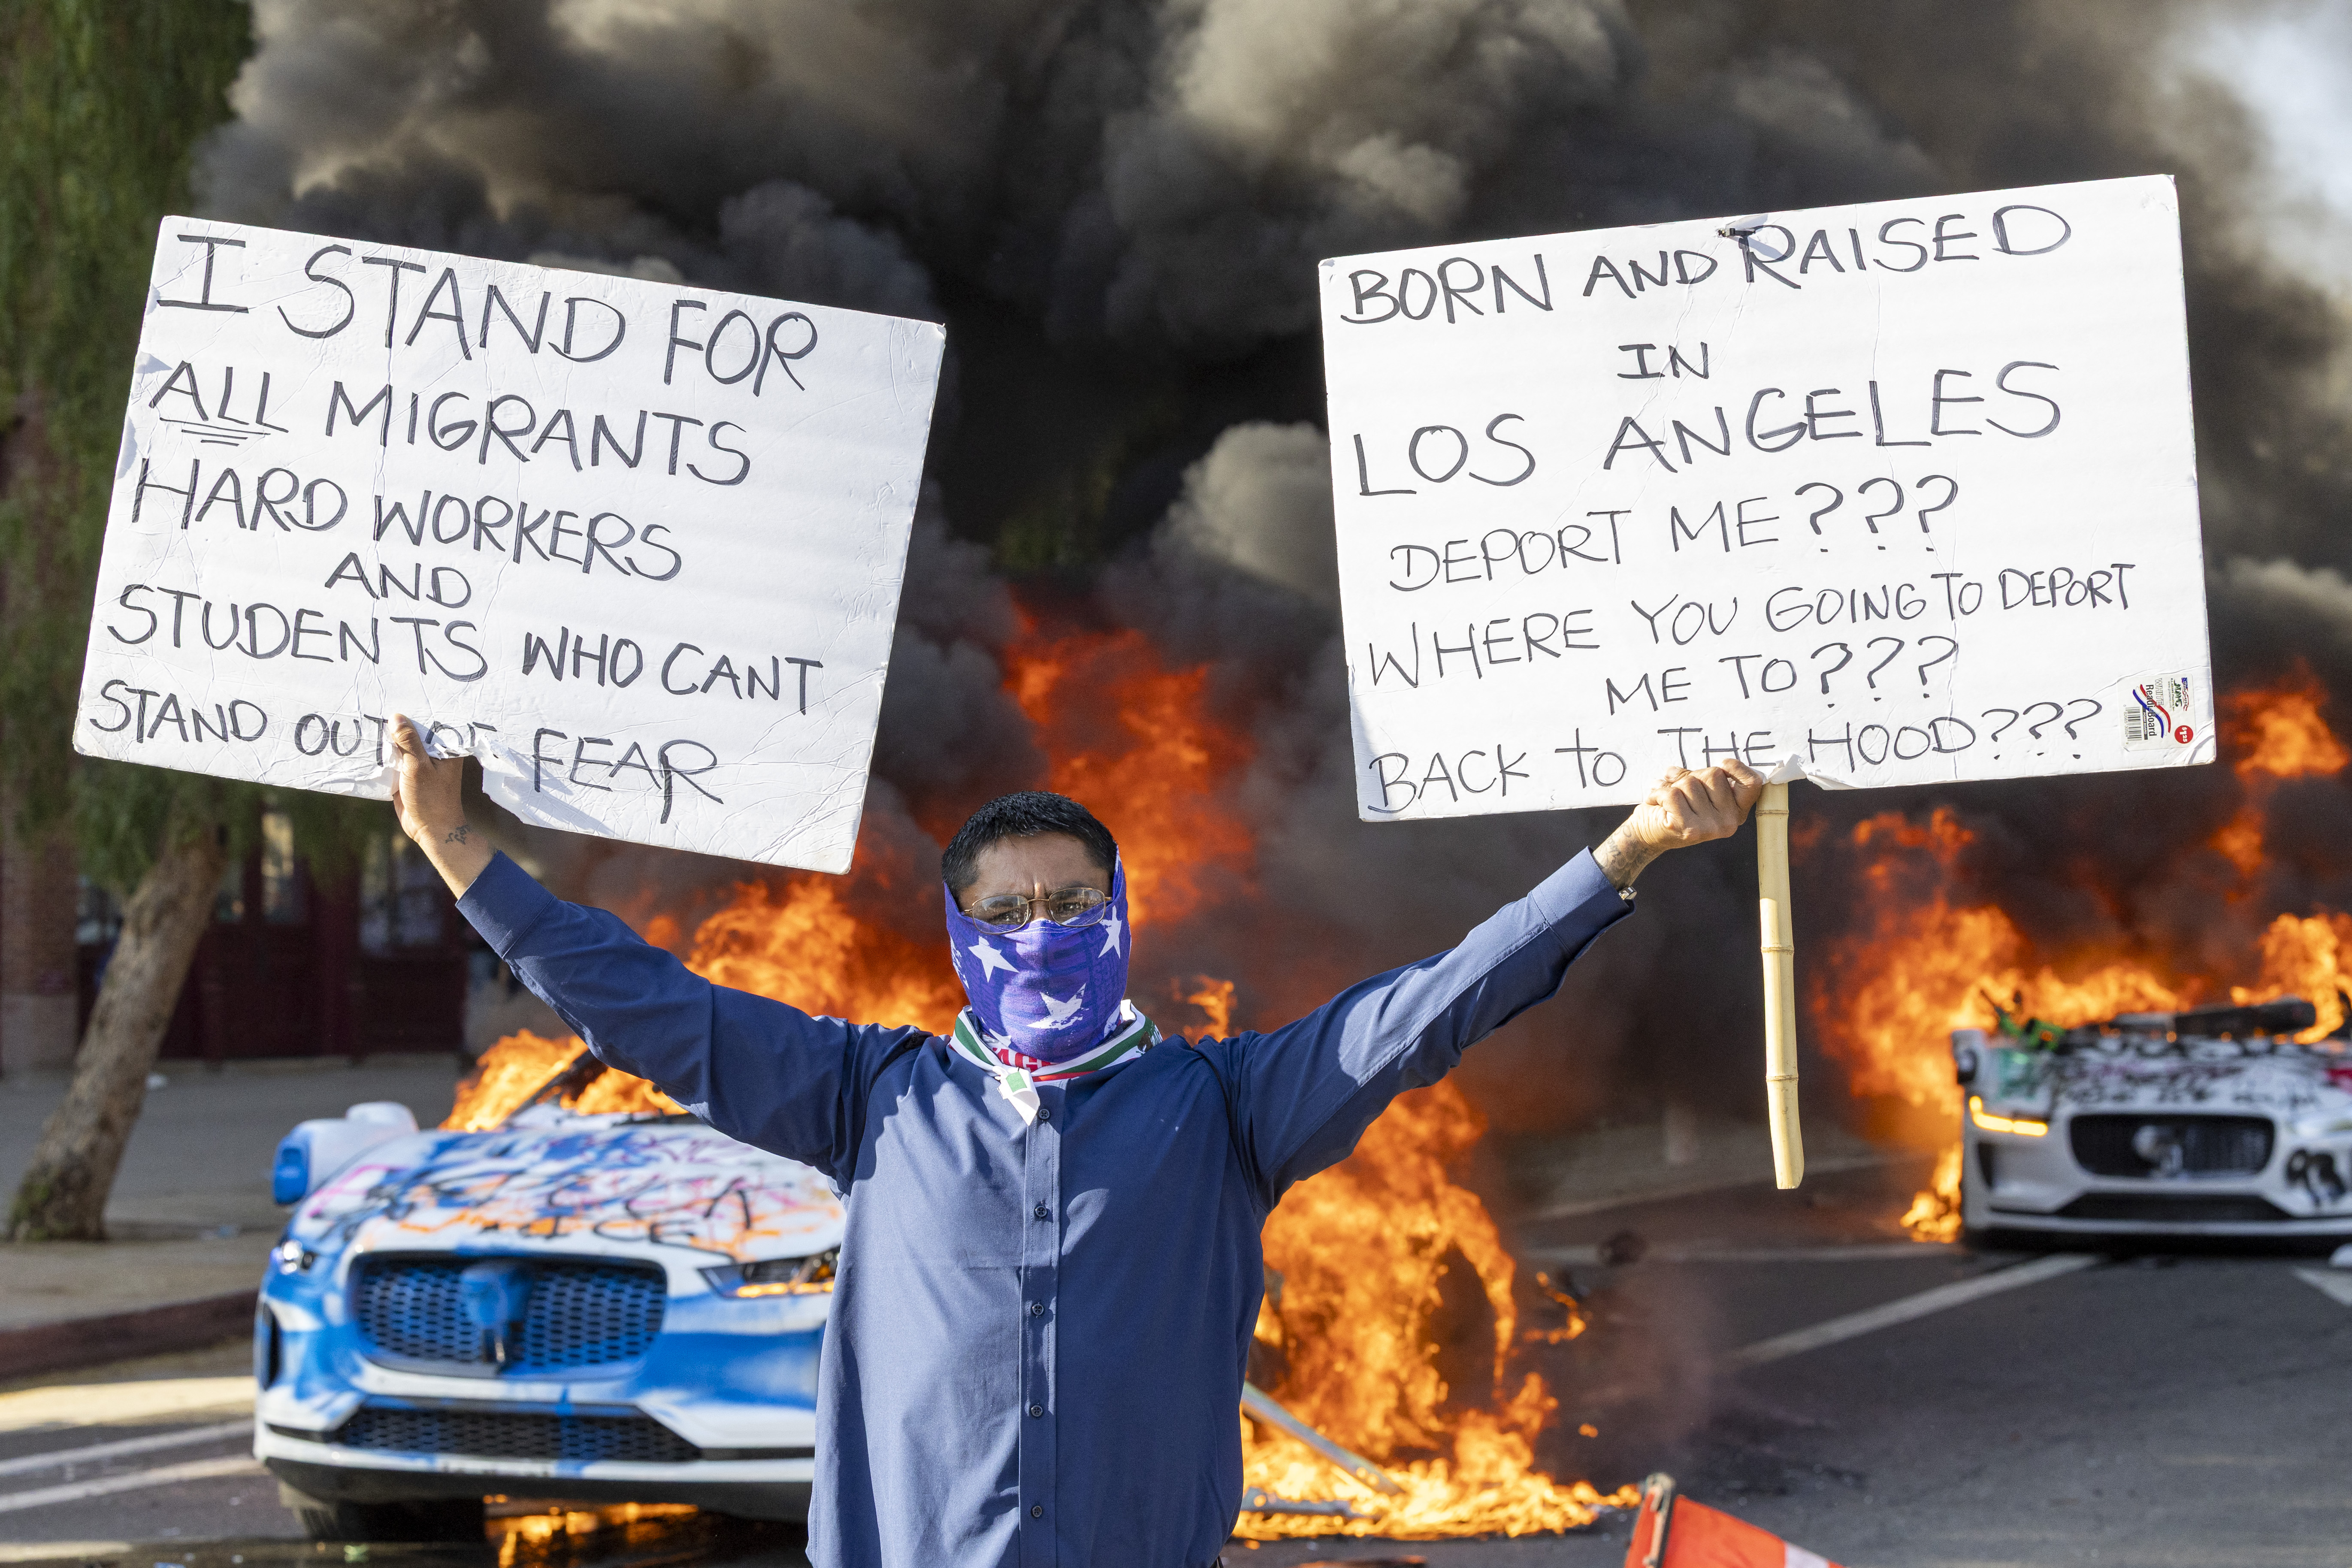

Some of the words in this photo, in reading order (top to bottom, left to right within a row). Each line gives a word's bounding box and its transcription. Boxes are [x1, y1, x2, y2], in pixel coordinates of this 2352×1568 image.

[157, 234, 248, 313] I
[278, 243, 626, 363] STAND
[664, 300, 817, 397] FOR
[1341, 254, 1553, 323] BORN
[1582, 251, 1718, 299] AND
[1738, 205, 2071, 289] RAISED
[1617, 342, 1709, 379] IN
[149, 361, 288, 432] ALL
[326, 381, 750, 486] MIGRANTS
[1353, 413, 1536, 496] LOS
[1603, 361, 2060, 473] ANGELES
[132, 458, 348, 532] HARD
[373, 490, 682, 581] WORKERS
[1390, 511, 1632, 591] DEPORT
[324, 552, 472, 609] AND
[1369, 610, 1600, 688] WHERE
[1632, 594, 1738, 645] YOU
[1766, 583, 1927, 632] GOING
[1931, 573, 1983, 621] TO
[1998, 563, 2136, 610] DEPORT
[107, 584, 487, 682] STUDENTS
[522, 626, 643, 688] WHO
[661, 642, 824, 716] CANT
[1606, 667, 1691, 716] ME
[2155, 678, 2164, 706] WHITE
[89, 680, 268, 743] STAND
[294, 713, 389, 767] OUT
[532, 728, 724, 824] FEAR
[1368, 744, 1530, 813] BACK
[1657, 726, 1776, 768] THE
[2146, 685, 2157, 736] Readi-Board
